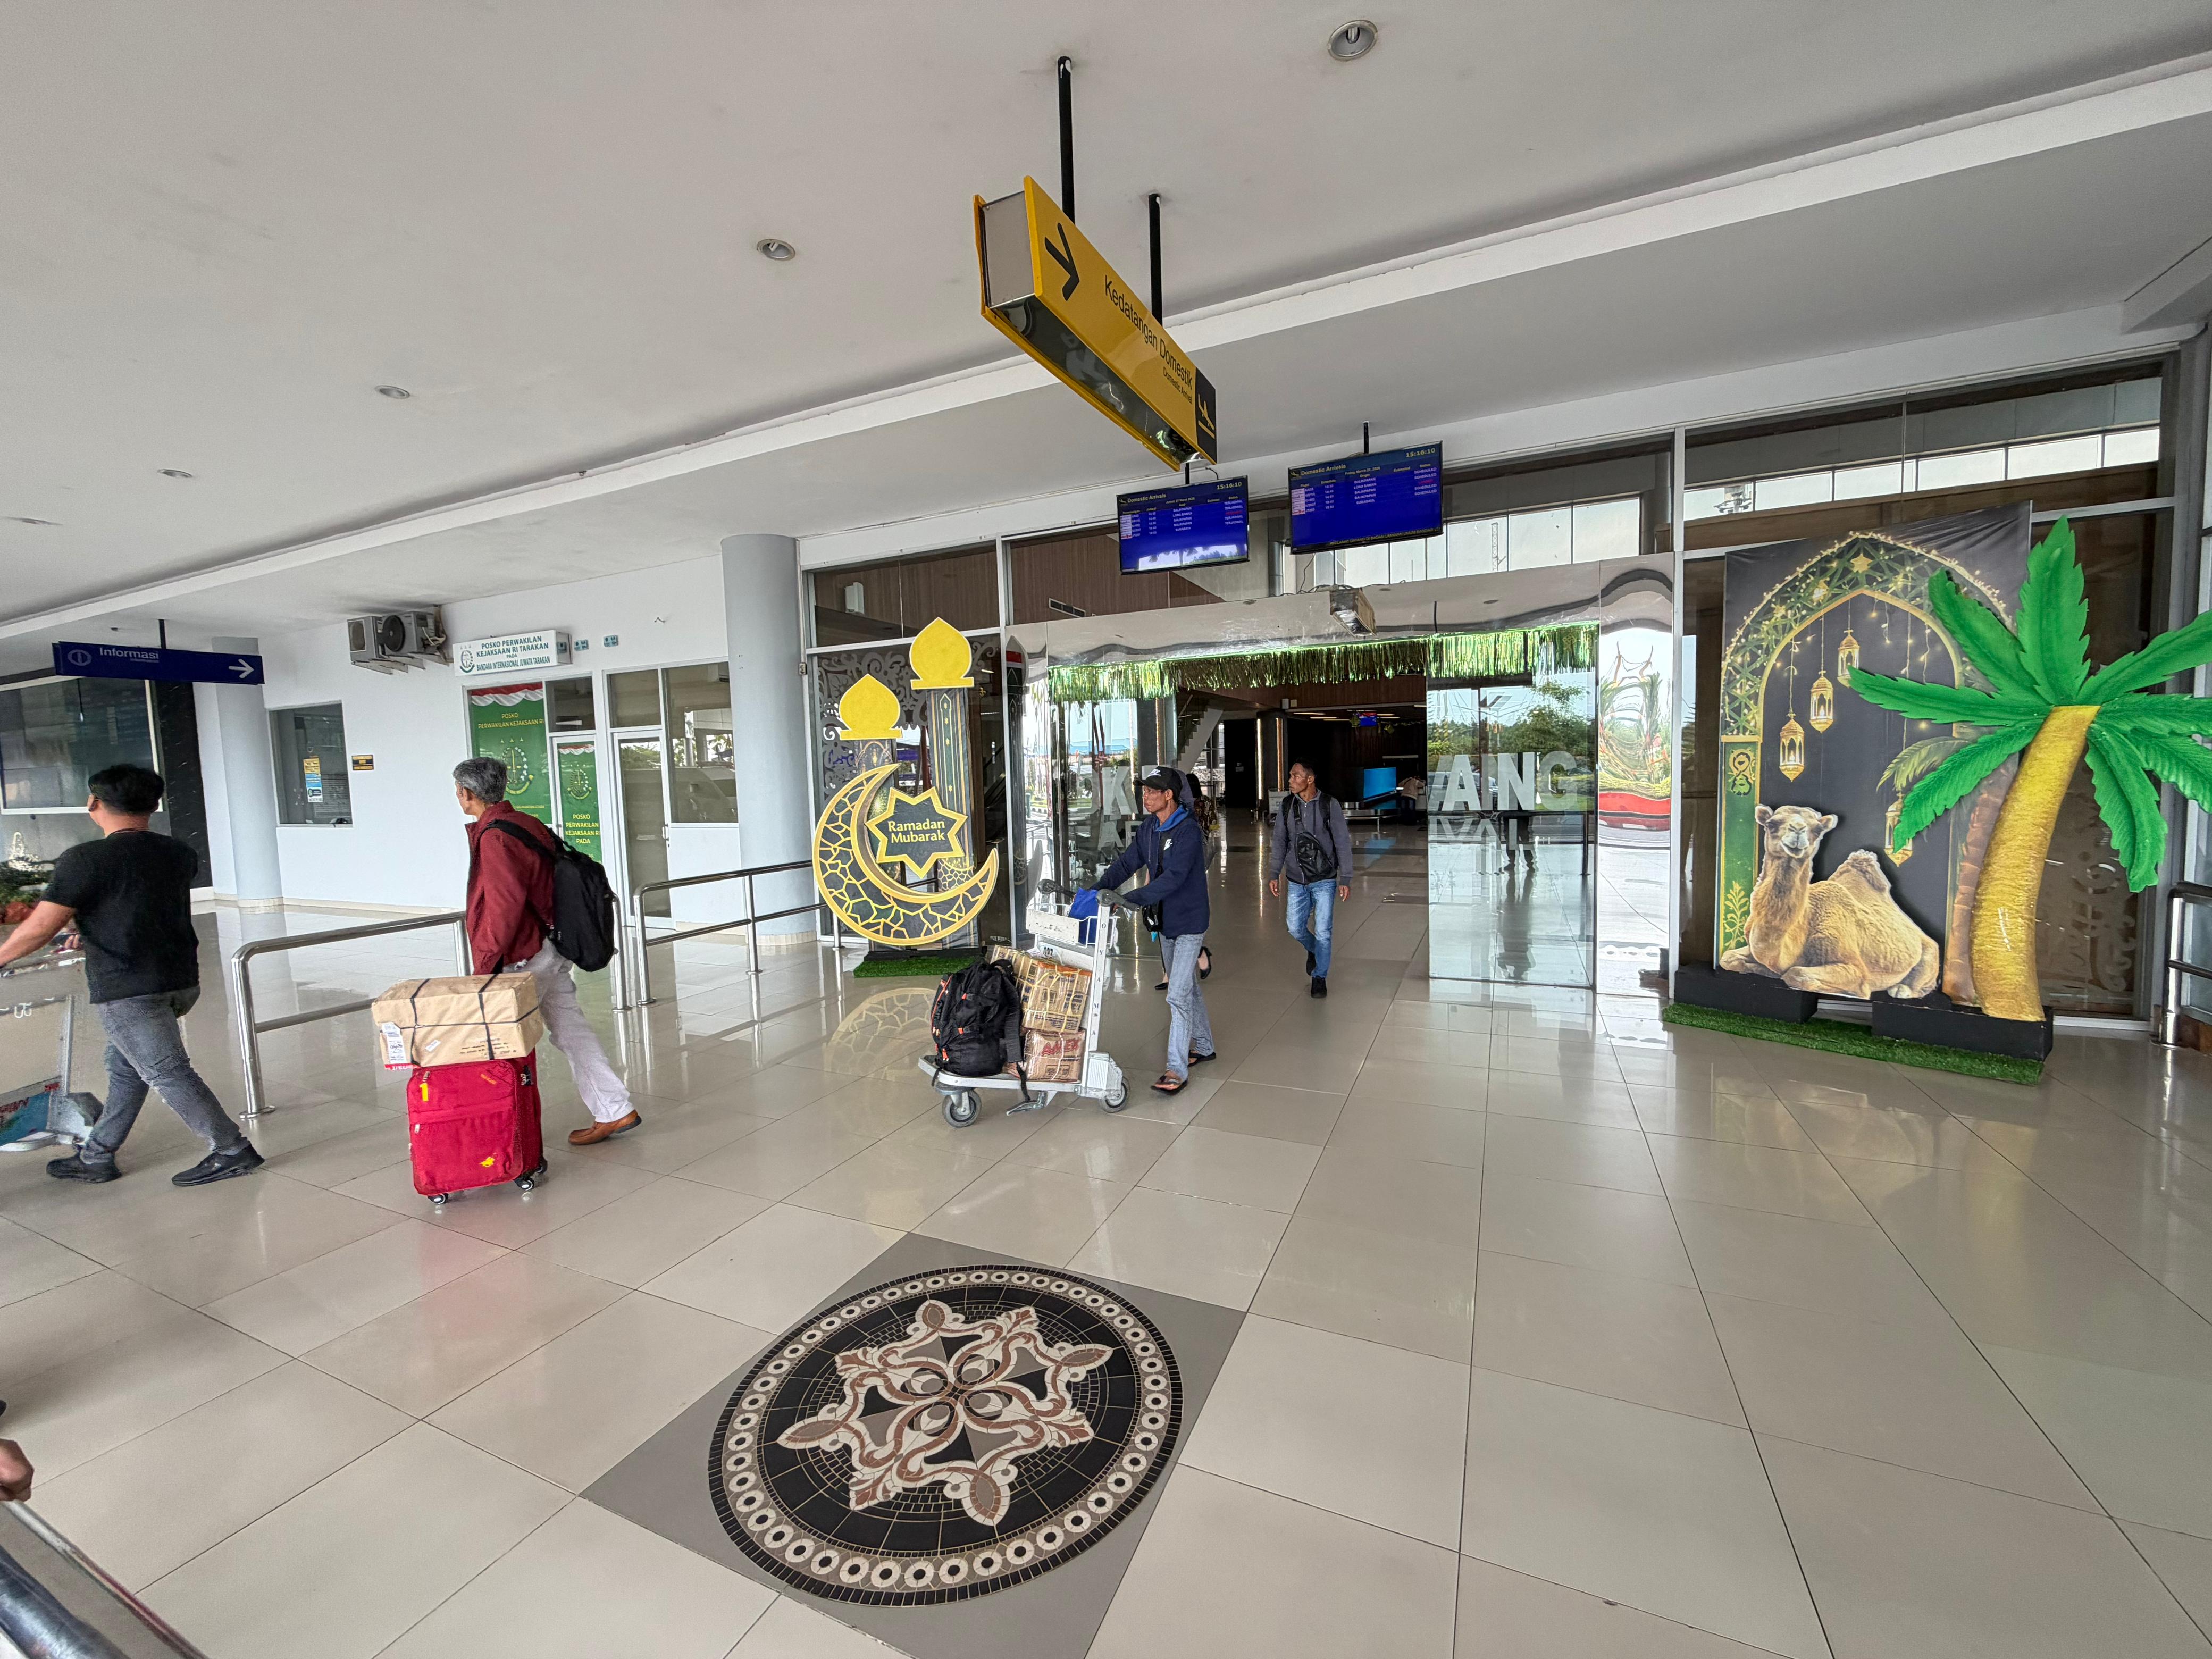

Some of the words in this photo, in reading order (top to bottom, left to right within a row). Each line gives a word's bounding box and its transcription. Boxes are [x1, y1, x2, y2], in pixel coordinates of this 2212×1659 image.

[1105, 274, 1158, 351] Kedatangan
[1160, 338, 1193, 390] Domestik
[1163, 366, 1181, 393] Domestic
[1405, 448, 1436, 458] 15:16:10
[1301, 467, 1325, 476] Domestic
[1216, 482, 1242, 490] 15:16:10
[502, 635, 542, 647] PERWAKILAN
[99, 647, 159, 660] Informasi
[476, 647, 510, 657] KEJAKSAAN
[520, 642, 549, 652] TARAKAN
[492, 660, 519, 669] INTERNASIONAL
[533, 655, 551, 664] TARAKAN
[888, 819, 945, 832] Ramadan
[891, 830, 946, 843] Mubarak
